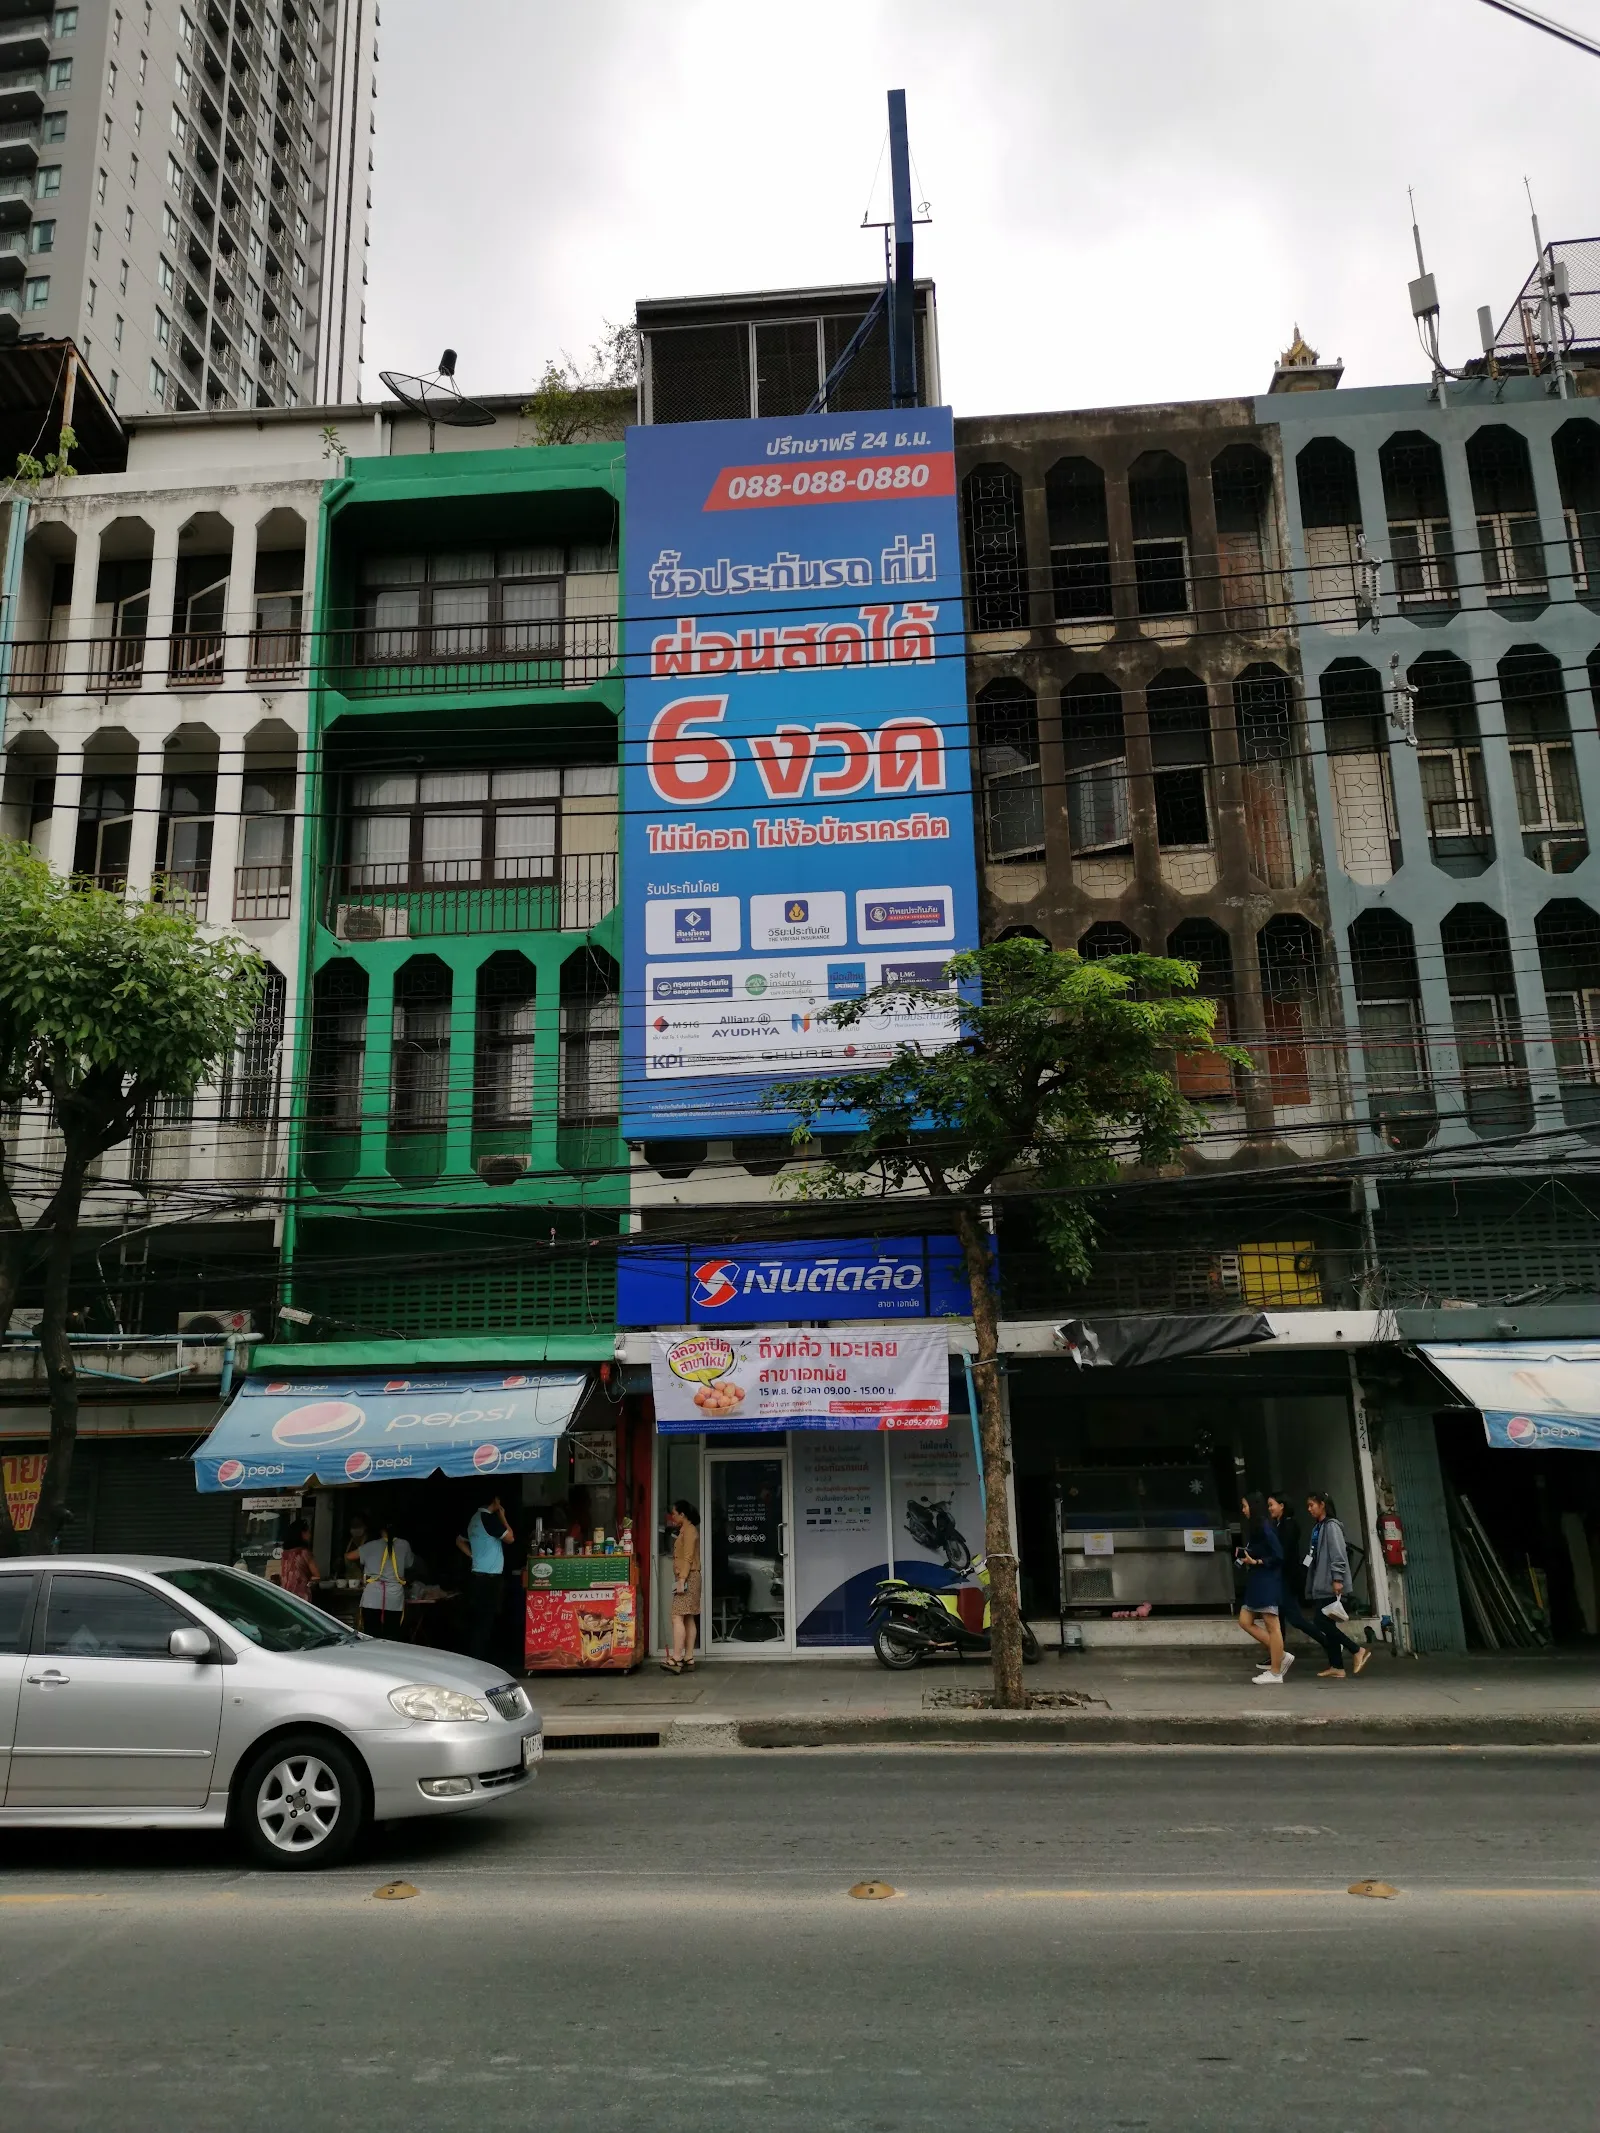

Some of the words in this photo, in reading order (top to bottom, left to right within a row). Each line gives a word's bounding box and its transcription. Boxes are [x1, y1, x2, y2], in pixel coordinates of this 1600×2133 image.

[766, 431, 856, 456] ปรึกษาฟรี
[862, 432, 887, 448] 24
[895, 431, 931, 447] ช.ม.
[728, 465, 930, 499] 088-088-0880
[649, 550, 872, 599] ซื้อประกันรถ
[881, 534, 936, 583] ที่นี่
[651, 603, 939, 680] ผ่อนสดได้
[647, 694, 736, 805] 6
[747, 716, 946, 799] งวด
[646, 822, 749, 853] ไม่มีดอก
[754, 812, 949, 848] ไม่ง้อบัตรเครดิต
[647, 880, 720, 895] รับประกันโดย
[769, 970, 796, 980] safety
[769, 979, 812, 987] insurance
[672, 1021, 700, 1029] MSIG
[720, 1016, 755, 1025] Allianz
[712, 1027, 780, 1038] AYUDHYA
[743, 1254, 922, 1294] เงินติดล้อ
[878, 1300, 895, 1308] สาขา
[670, 1338, 731, 1361] ฉลองเปิด
[759, 1335, 822, 1359] ถึงแล้ว
[830, 1341, 898, 1358] แวะเลย
[679, 1352, 726, 1373] สาขาใหม่
[759, 1364, 847, 1383] สาขาเอกมัย
[759, 1388, 769, 1396] 15
[823, 1386, 851, 1395] 09.00
[860, 1386, 885, 1395] 15.00
[383, 1403, 519, 1432] pepsi
[896, 1418, 943, 1426] 0-2092-7705
[1540, 1427, 1580, 1438] pepsi
[504, 1446, 541, 1461] pepsi
[248, 1462, 284, 1478] pepsi
[376, 1455, 412, 1470] pepsi
